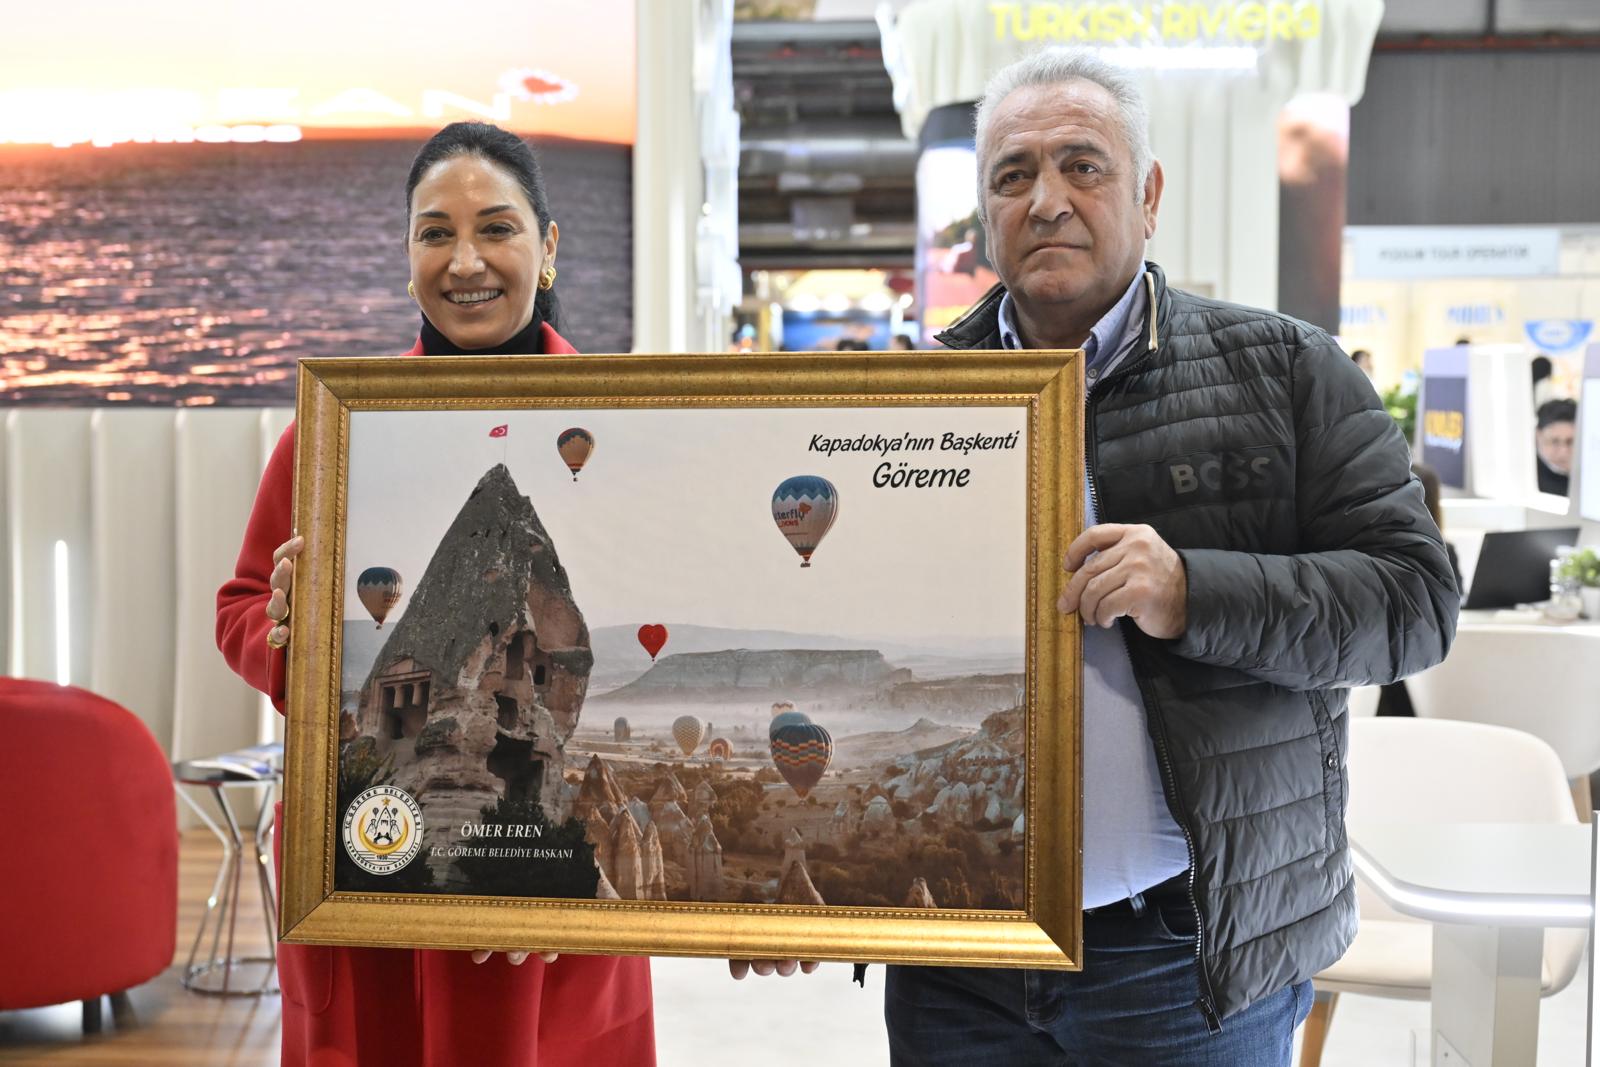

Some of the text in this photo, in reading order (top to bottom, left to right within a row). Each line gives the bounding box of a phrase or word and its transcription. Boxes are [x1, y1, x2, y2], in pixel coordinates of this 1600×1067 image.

[988, 3, 1152, 42] TURKISH
[807, 430, 1020, 457] Kapadokya'nın Başkenti
[872, 461, 971, 489] Göreme
[1169, 456, 1273, 495] BOSS
[460, 820, 544, 839] ÖMER EREN
[447, 845, 487, 858] GÖREME
[488, 846, 531, 858] BELEDİYE
[533, 848, 574, 861] BAŞKANI
